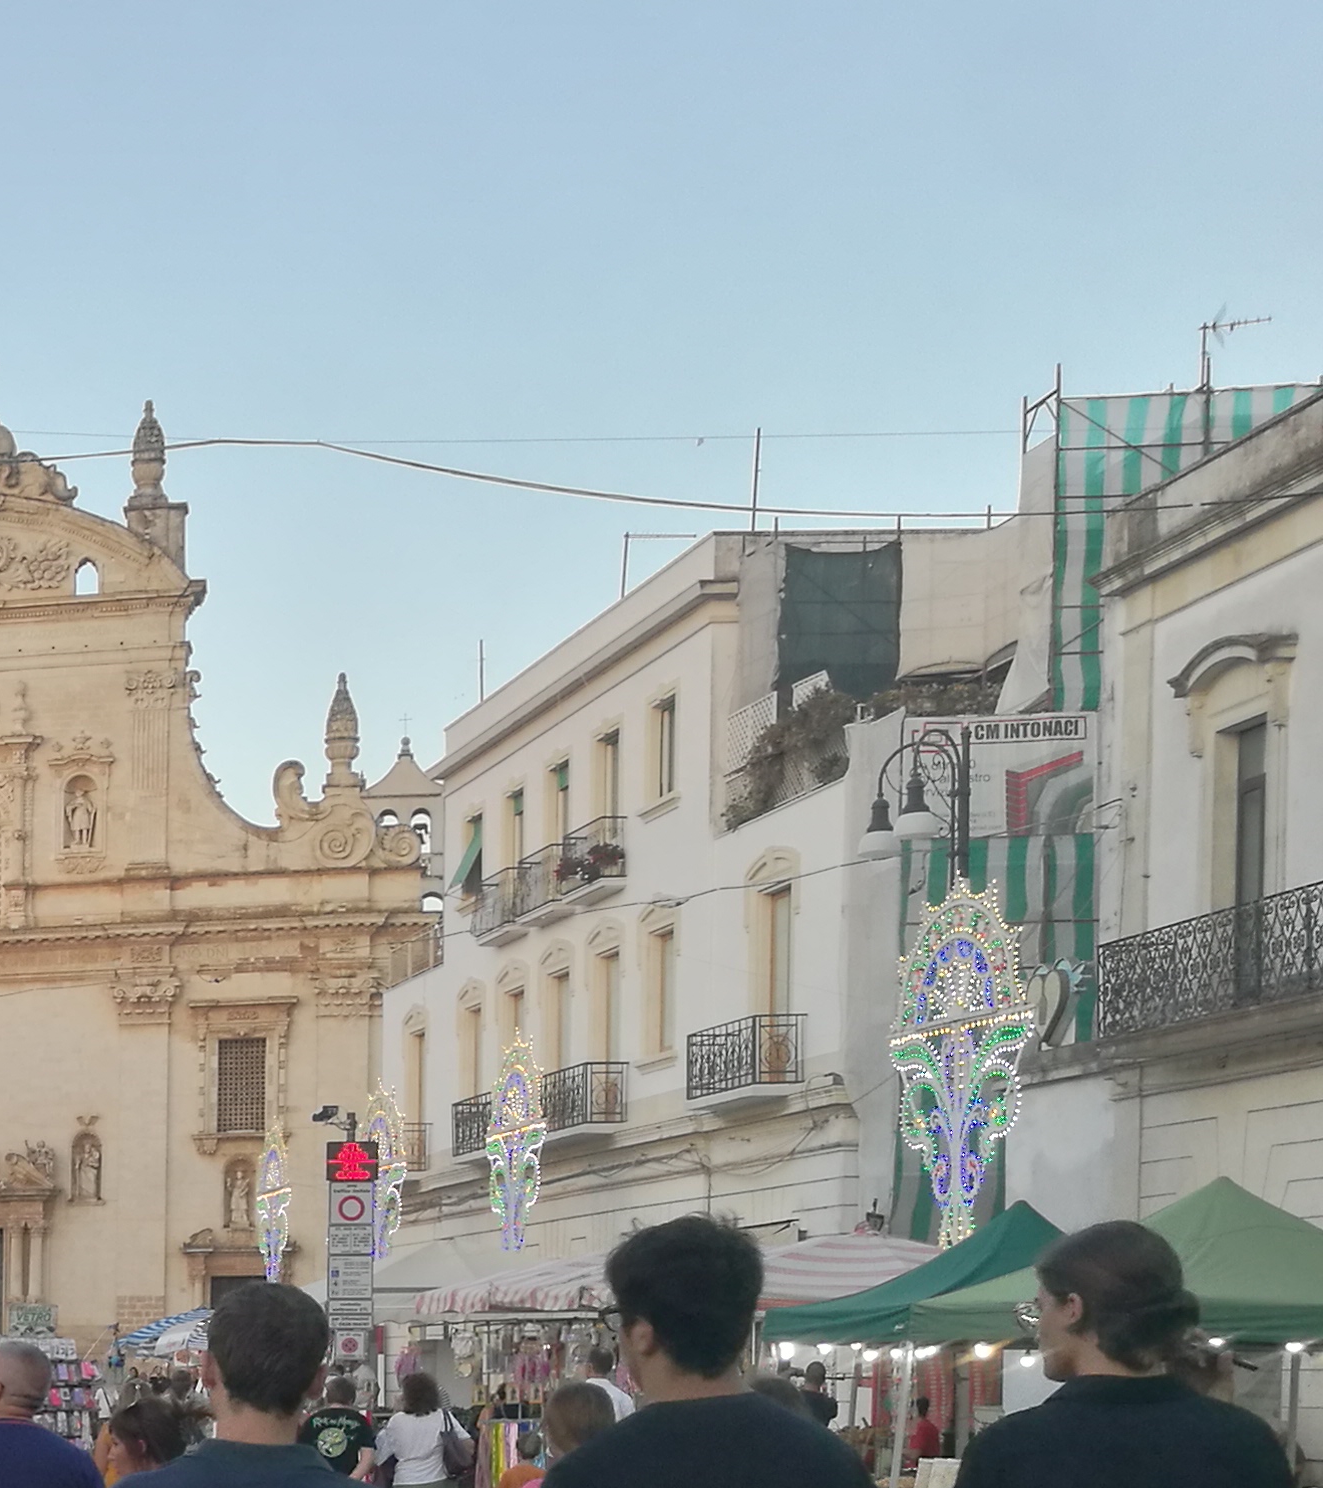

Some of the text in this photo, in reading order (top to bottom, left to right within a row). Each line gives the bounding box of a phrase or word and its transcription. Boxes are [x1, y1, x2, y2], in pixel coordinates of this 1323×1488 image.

[974, 719, 1079, 741] CM INTONACI
[969, 772, 991, 783] stro
[16, 1312, 52, 1322] VETRO
